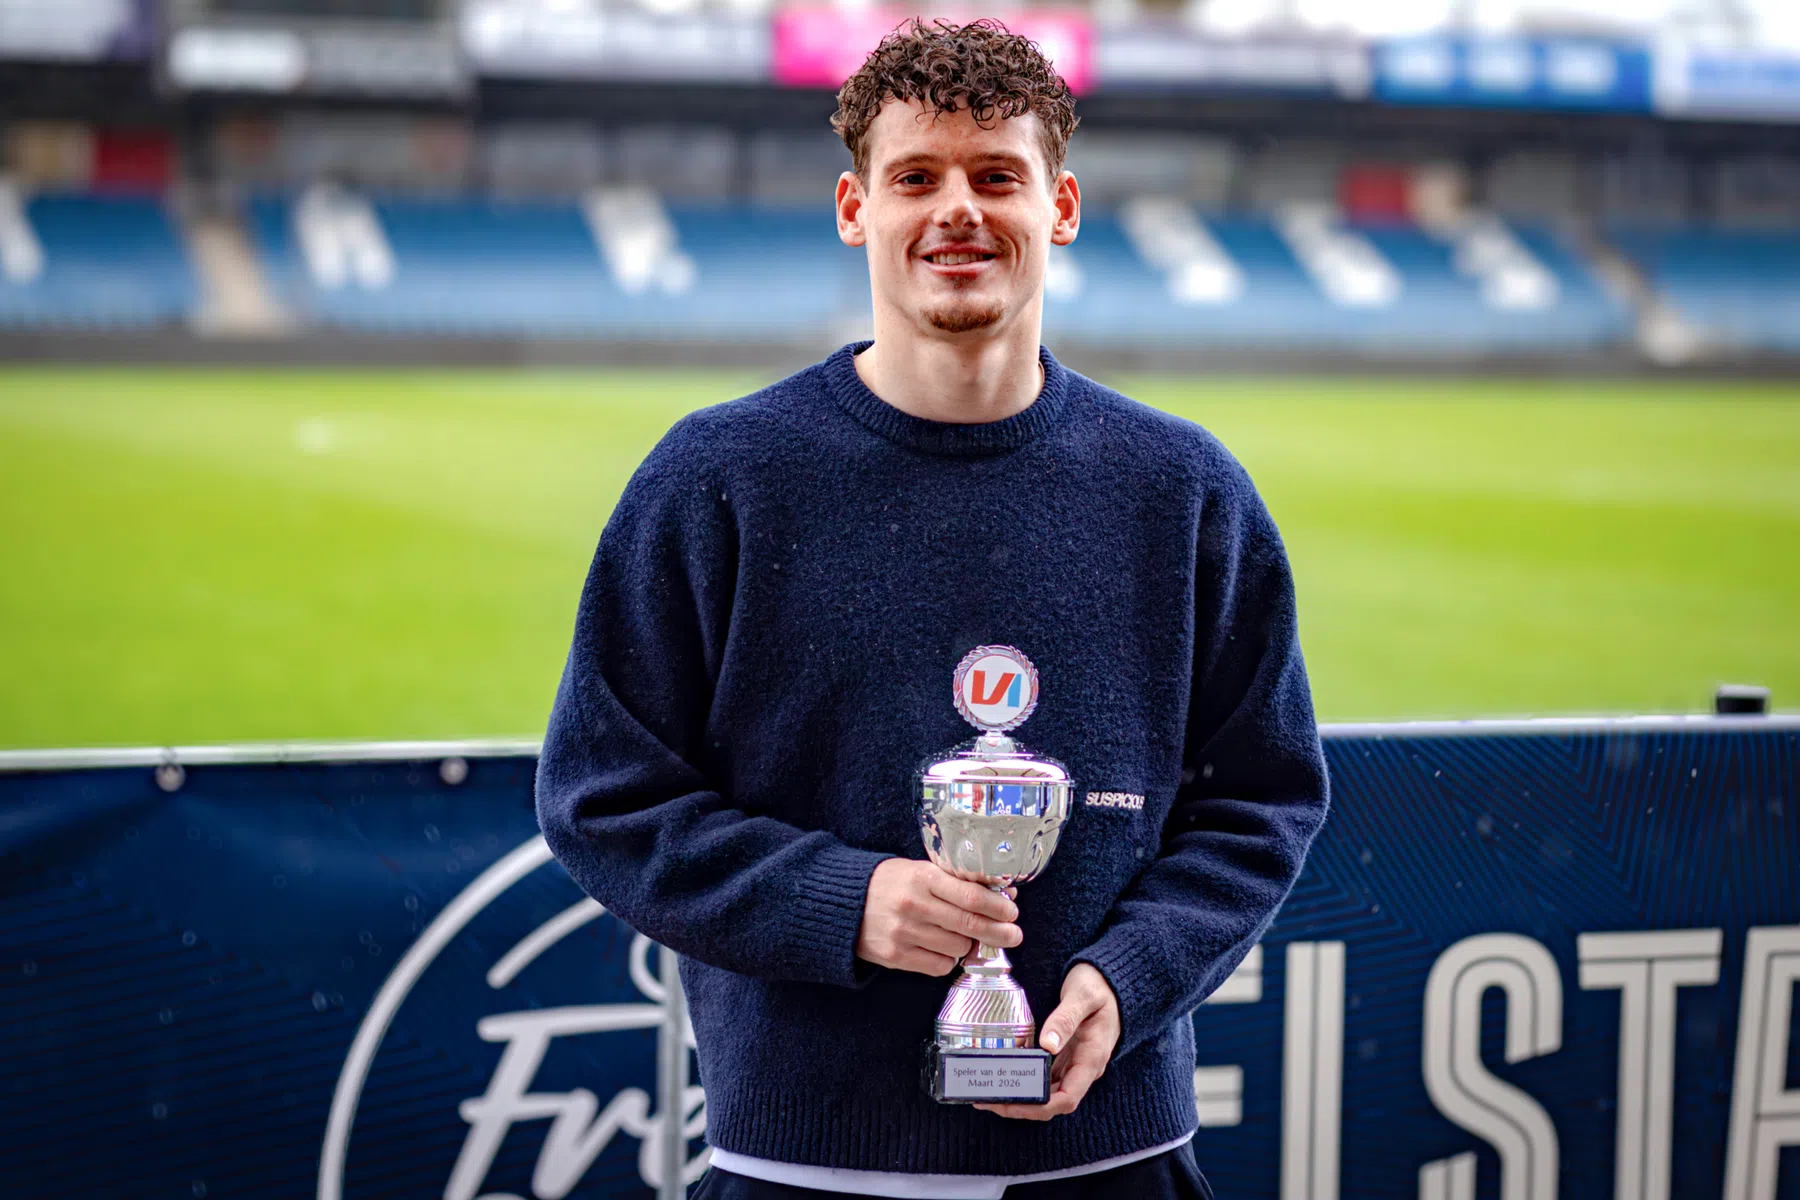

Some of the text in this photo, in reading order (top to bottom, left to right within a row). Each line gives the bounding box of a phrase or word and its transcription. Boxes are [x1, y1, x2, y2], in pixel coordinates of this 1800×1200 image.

[971, 670, 1022, 708] VI
[953, 1067, 977, 1078] Speler
[998, 1068, 1007, 1076] de
[1010, 1068, 1036, 1076] maand
[968, 1079, 994, 1087] Maart
